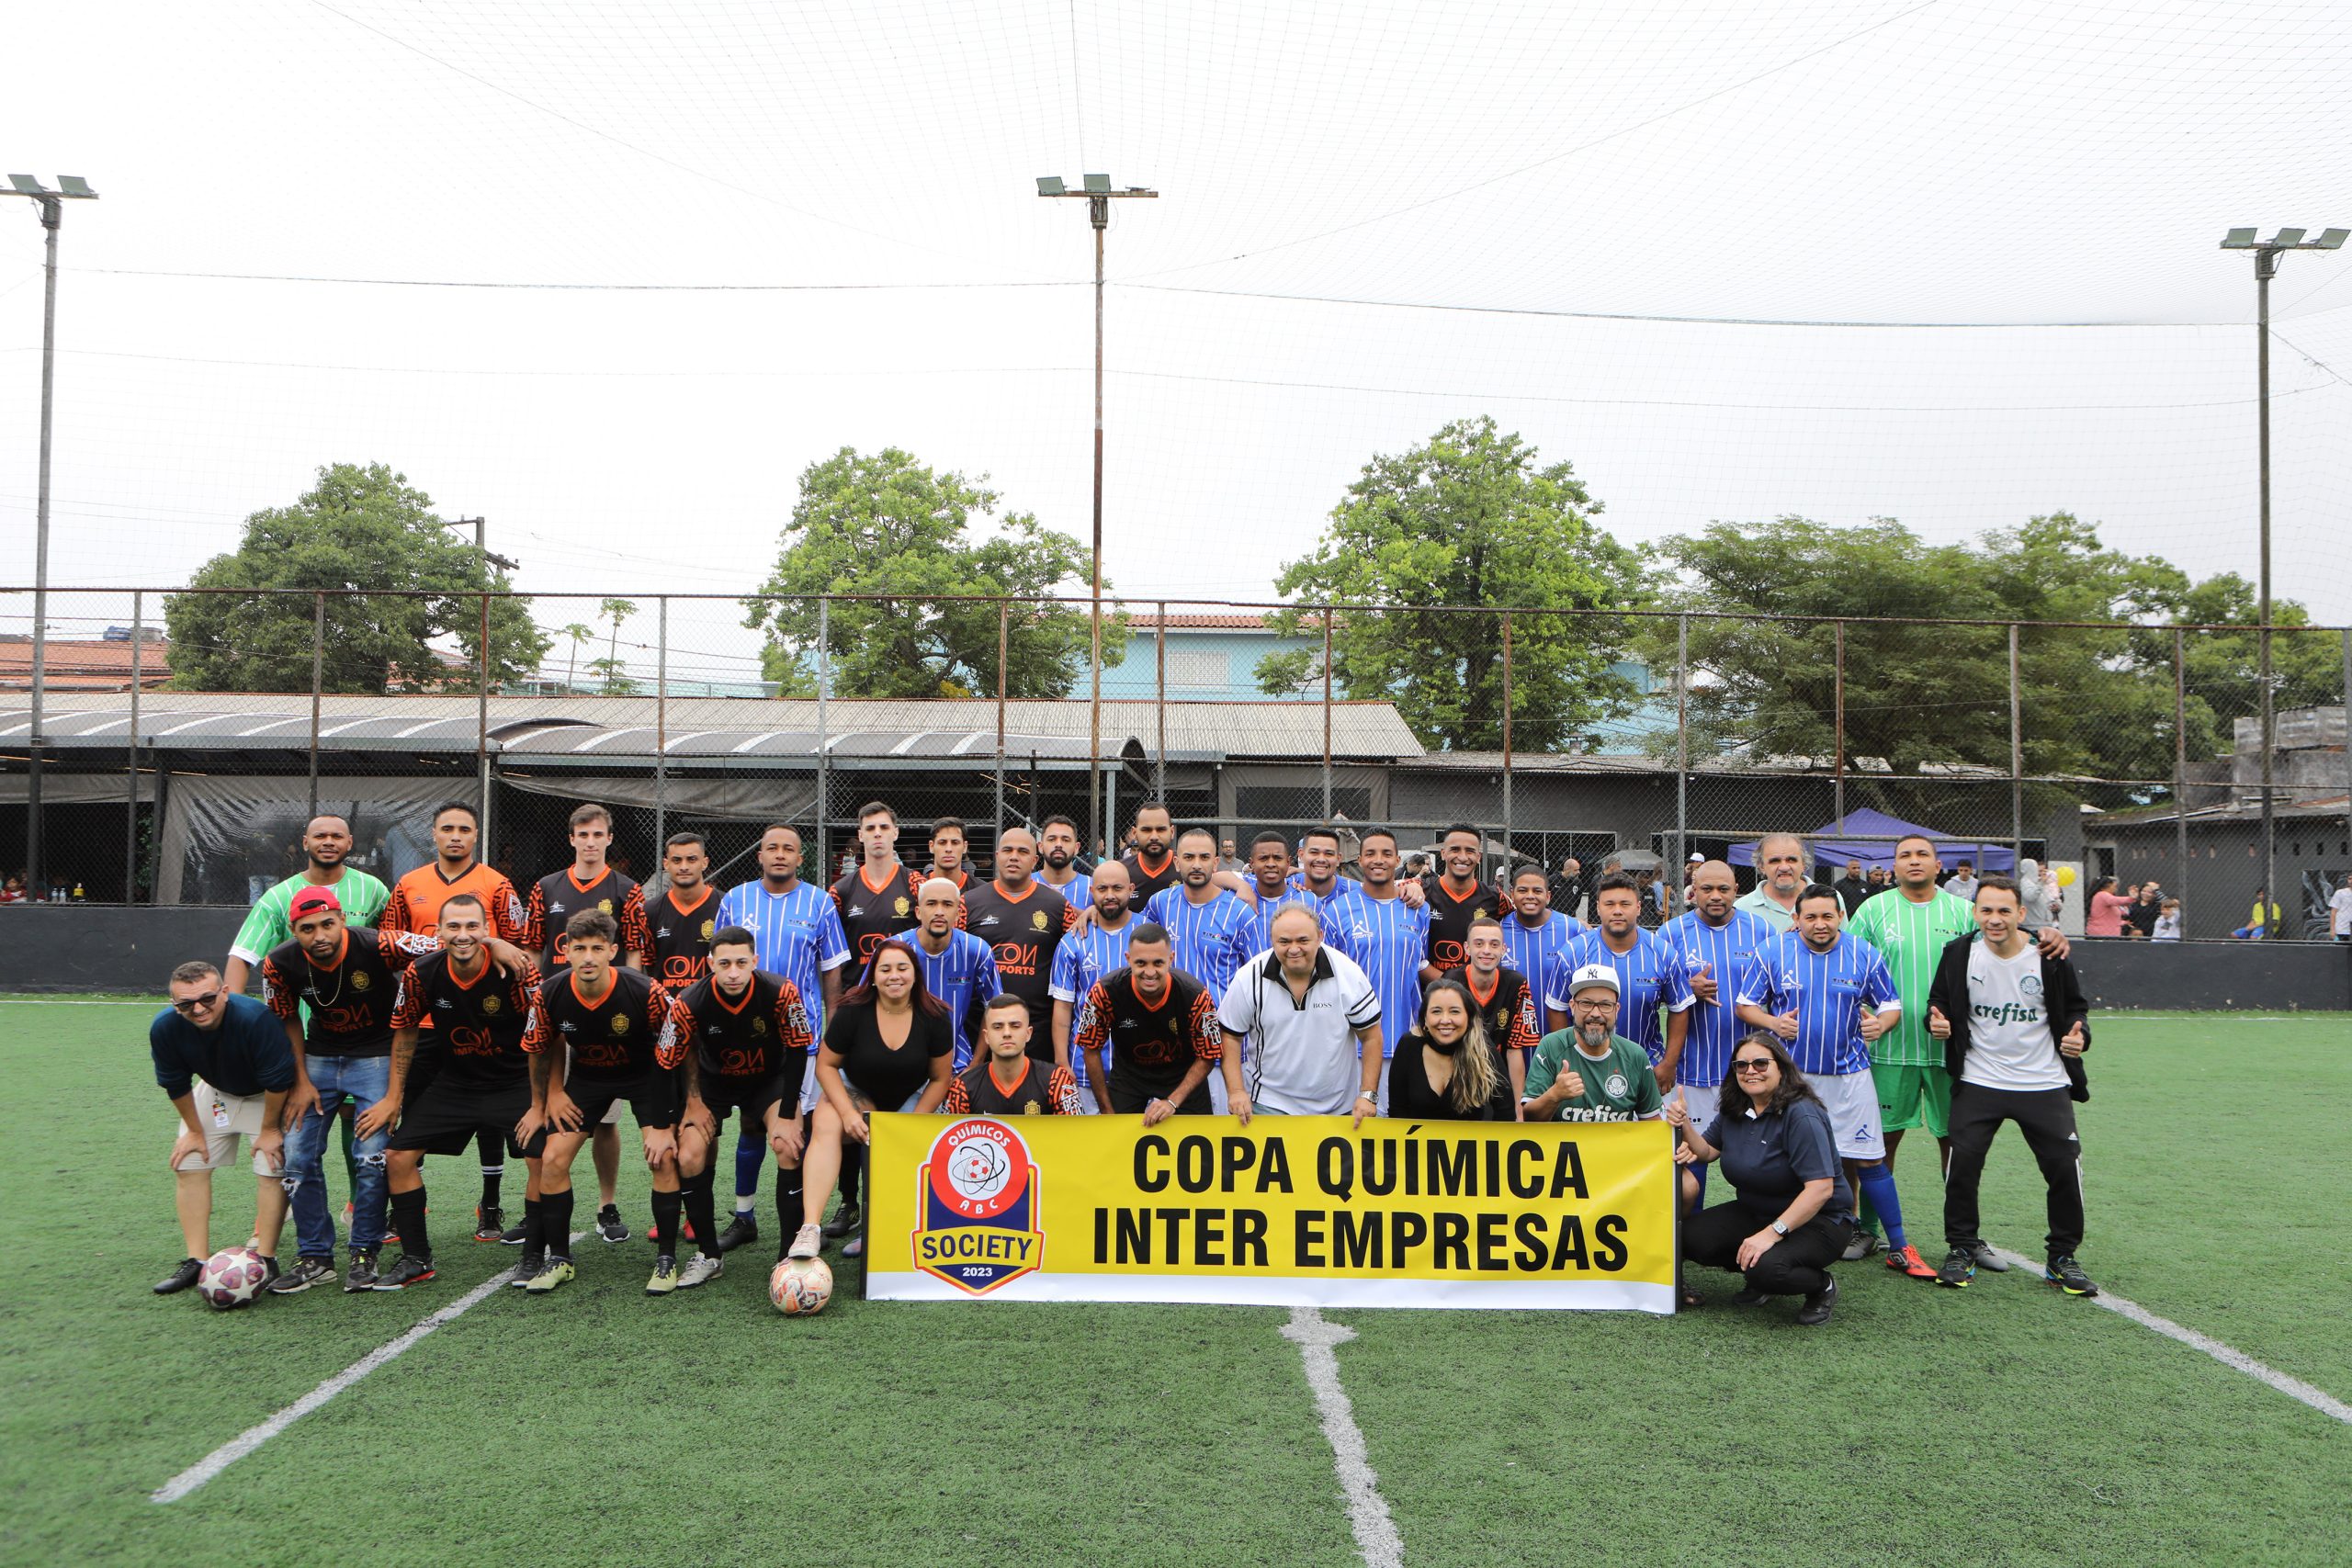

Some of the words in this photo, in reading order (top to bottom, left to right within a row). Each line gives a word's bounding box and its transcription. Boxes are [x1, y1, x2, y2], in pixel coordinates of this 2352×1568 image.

[1974, 1002, 2039, 1027] crefisa
[1562, 1105, 1630, 1122] crefisa
[947, 1122, 1011, 1148] QUÍMICOS
[1135, 1135, 1293, 1192] COPA
[1317, 1123, 1589, 1201] QUÍMICA
[922, 1234, 1033, 1260] SOCIETY
[1095, 1208, 1268, 1266] INTER
[1295, 1211, 1627, 1271] EMPRESAS
[962, 1267, 993, 1277] 2023
